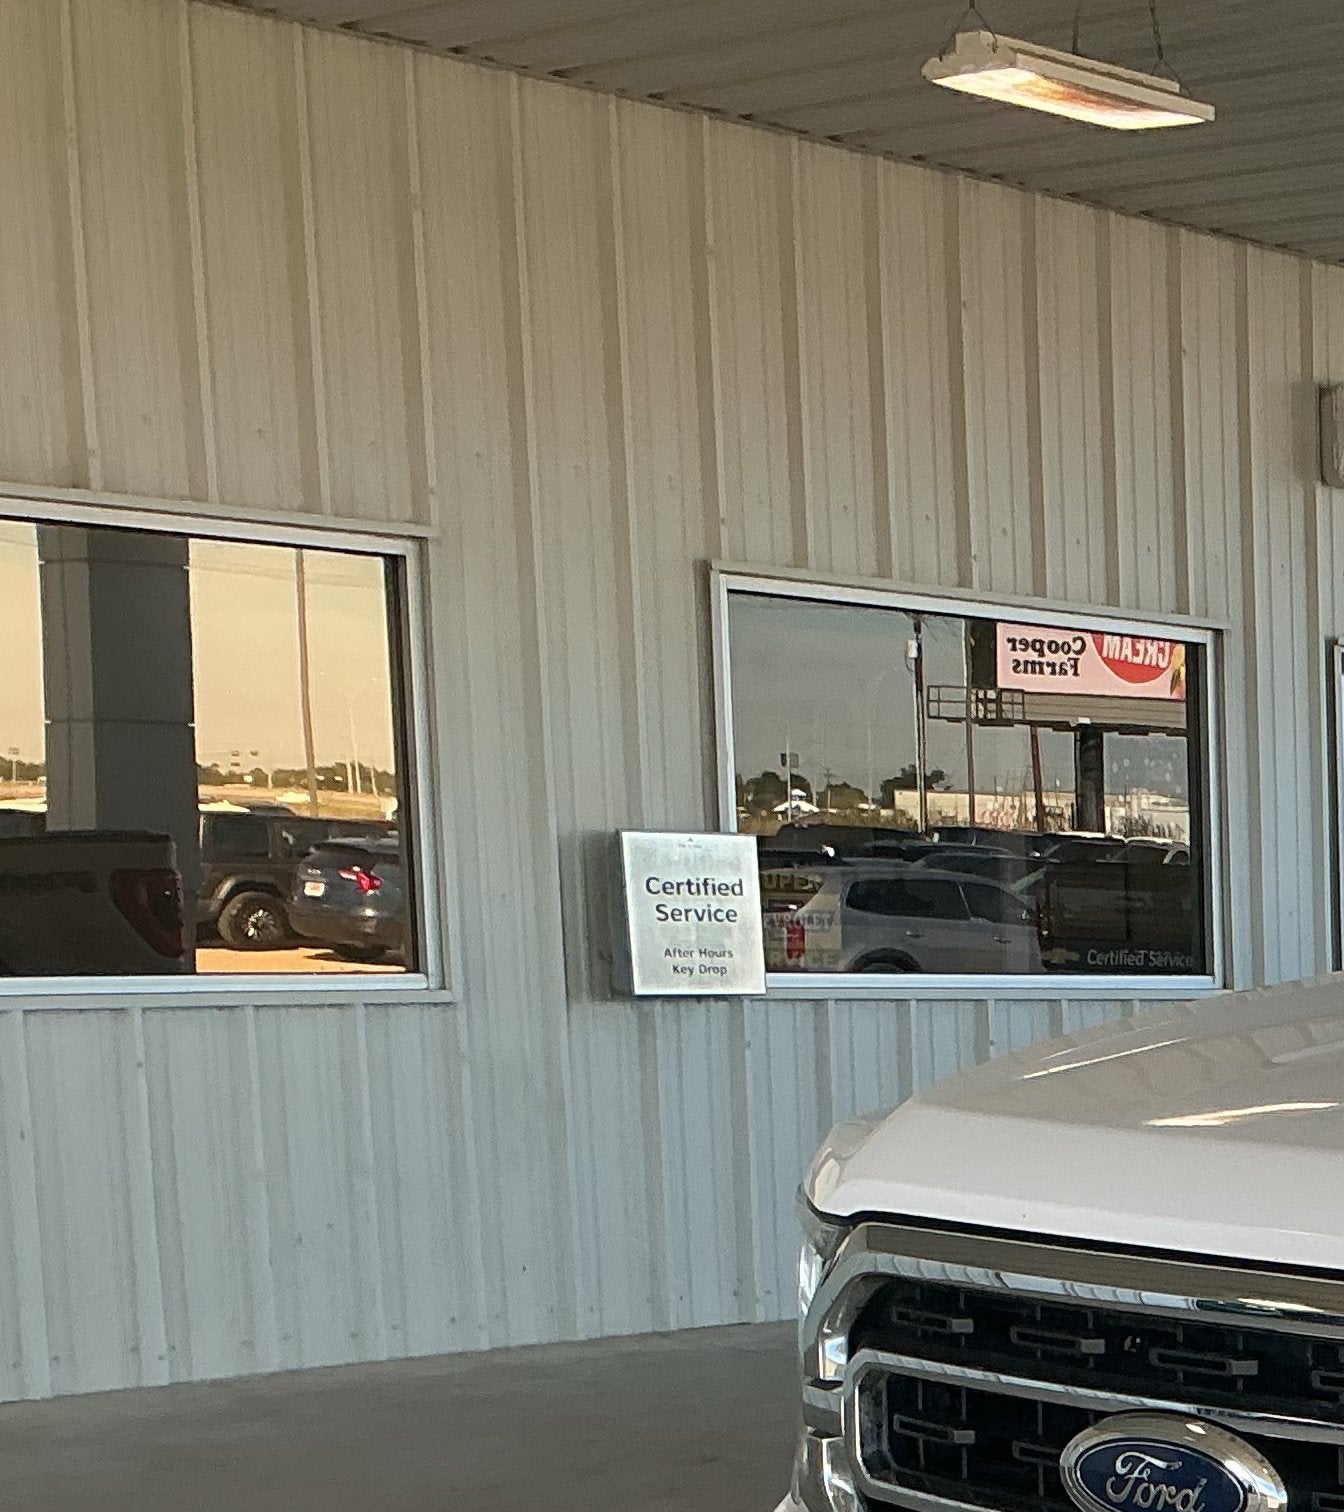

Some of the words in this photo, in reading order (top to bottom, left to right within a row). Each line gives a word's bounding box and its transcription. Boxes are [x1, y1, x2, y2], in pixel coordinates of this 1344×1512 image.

[645, 876, 744, 896] Certified
[655, 903, 738, 922] Service
[664, 948, 694, 958] After
[699, 948, 733, 958] Hours
[1087, 950, 1145, 966] Certified
[1149, 951, 1195, 967] Service
[672, 964, 694, 977] Key
[699, 964, 728, 977] Drop
